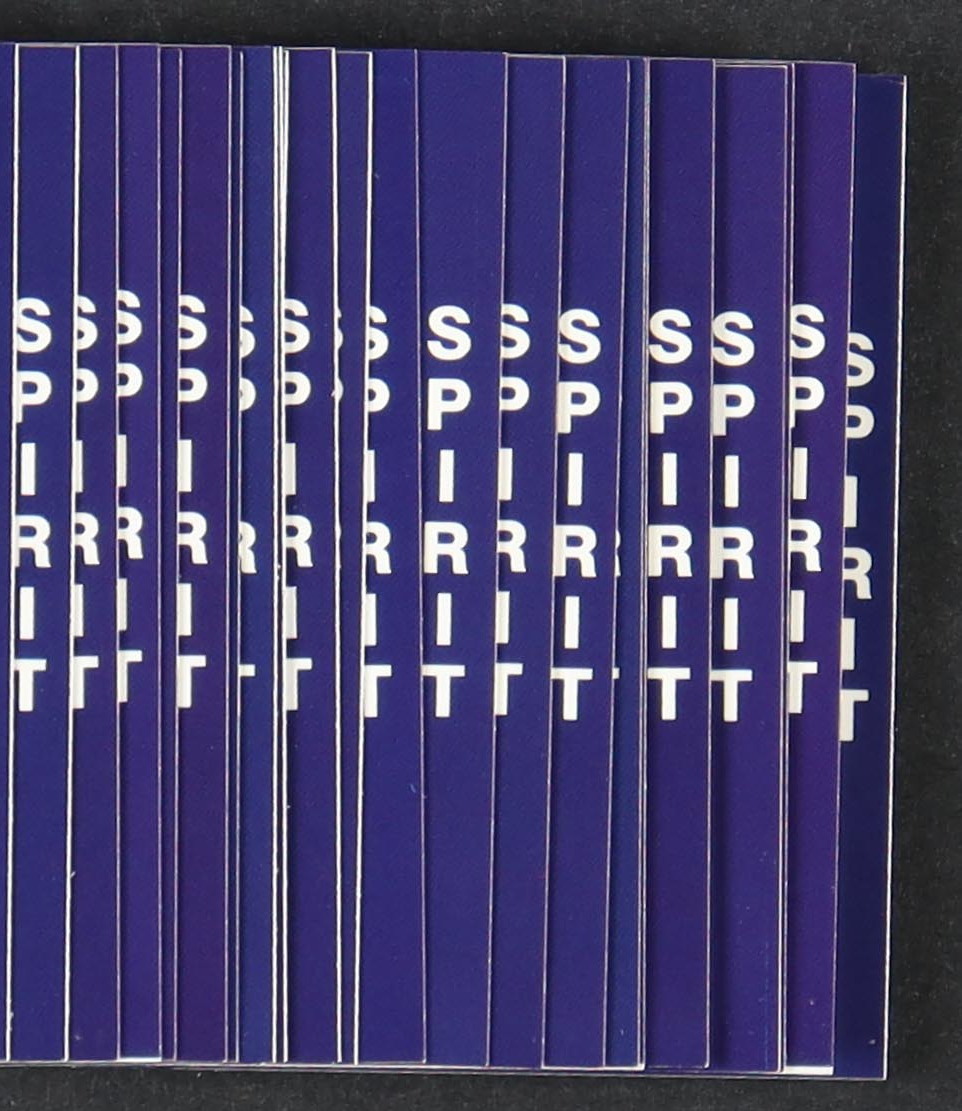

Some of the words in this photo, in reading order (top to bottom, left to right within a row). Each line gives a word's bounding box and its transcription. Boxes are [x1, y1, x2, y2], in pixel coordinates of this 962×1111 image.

[14, 297, 52, 712] SPIRIT
[176, 294, 209, 708] SPIRIT
[422, 305, 472, 718] SPIRIT
[494, 303, 531, 716] SPIRIT
[550, 308, 602, 721] SPIRIT
[647, 308, 694, 721] SPIRIT
[710, 311, 756, 722] SPIRIT
[787, 303, 826, 714] SPIRIT
[838, 332, 876, 742] SPIRIT
